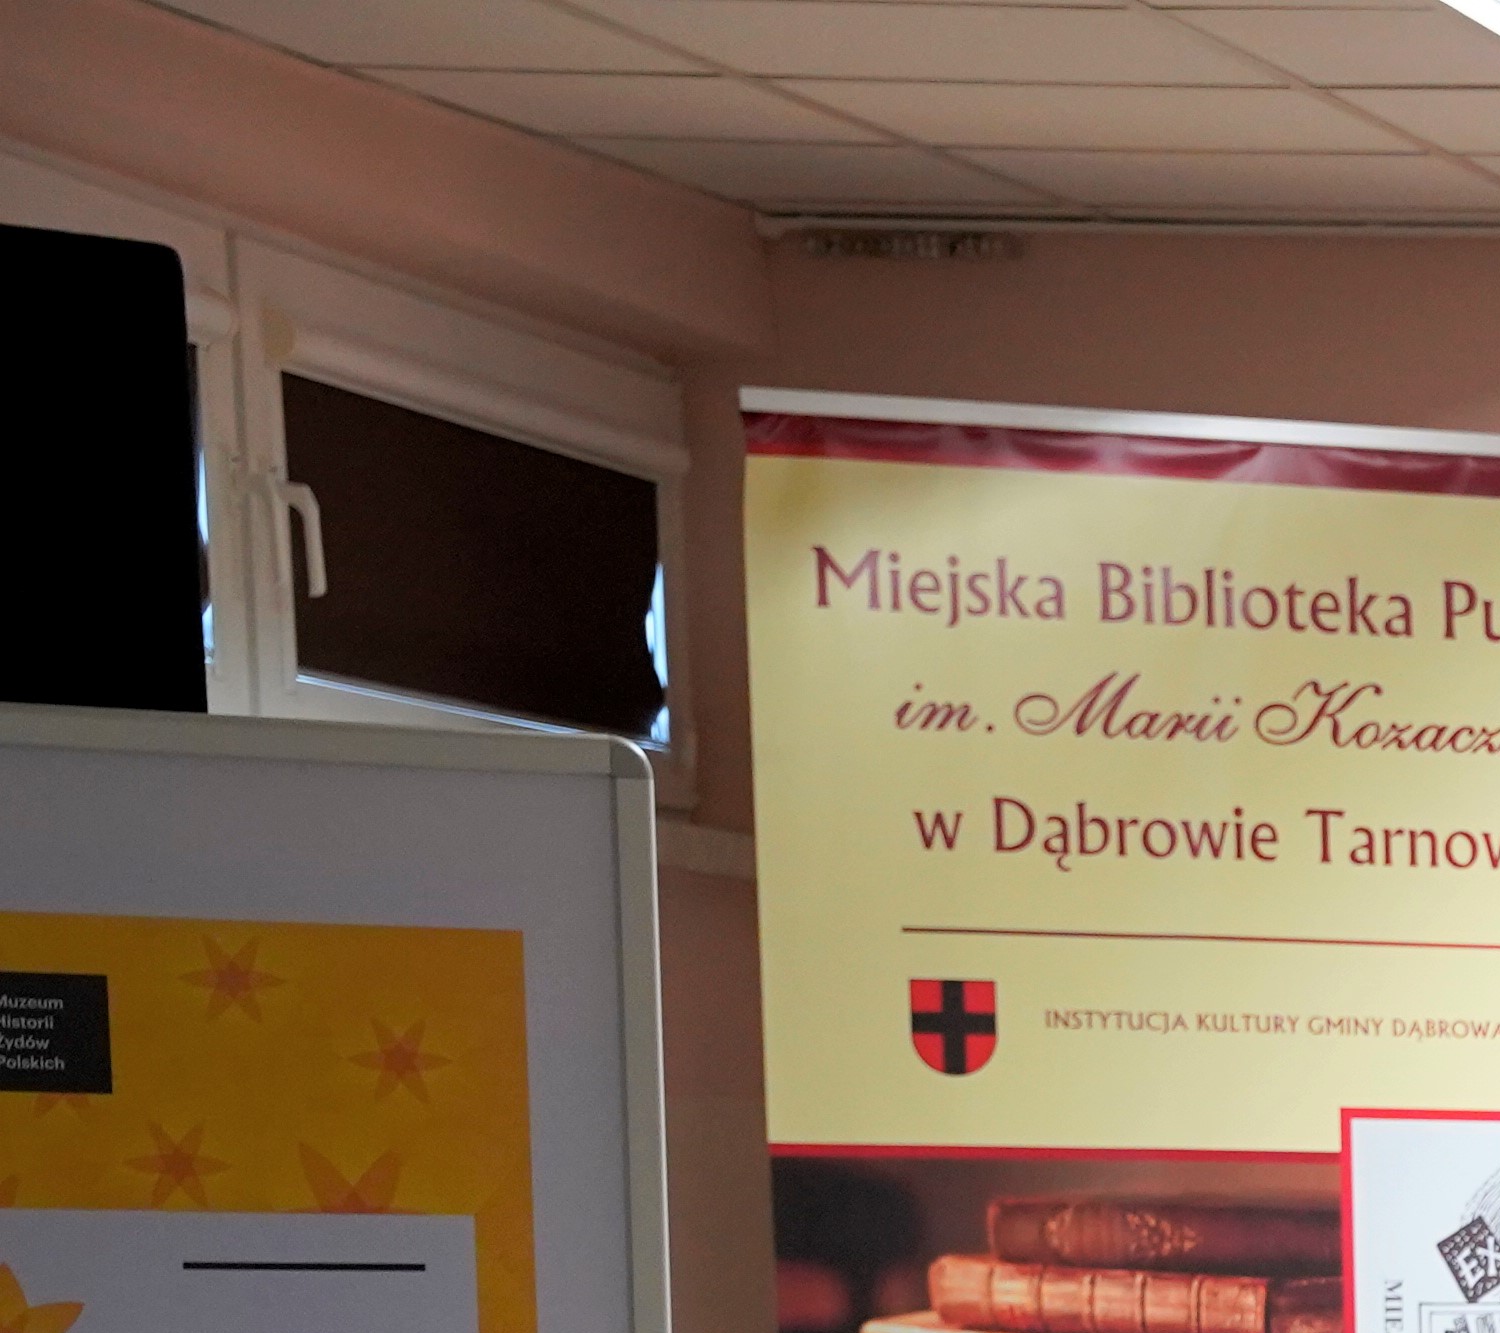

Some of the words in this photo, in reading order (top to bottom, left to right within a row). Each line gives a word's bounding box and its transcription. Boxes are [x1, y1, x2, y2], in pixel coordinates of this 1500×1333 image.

[811, 545, 1065, 631] Miejska
[1097, 561, 1415, 641] Biblioteka
[894, 682, 996, 734] im.
[1014, 671, 1241, 745] Marii
[913, 807, 962, 852] w
[993, 796, 1281, 873] Dąbrowie
[1044, 1009, 1190, 1035] INSTYTUCJA
[1196, 1013, 1300, 1035] KULTURY
[1307, 1016, 1384, 1038] GMINY
